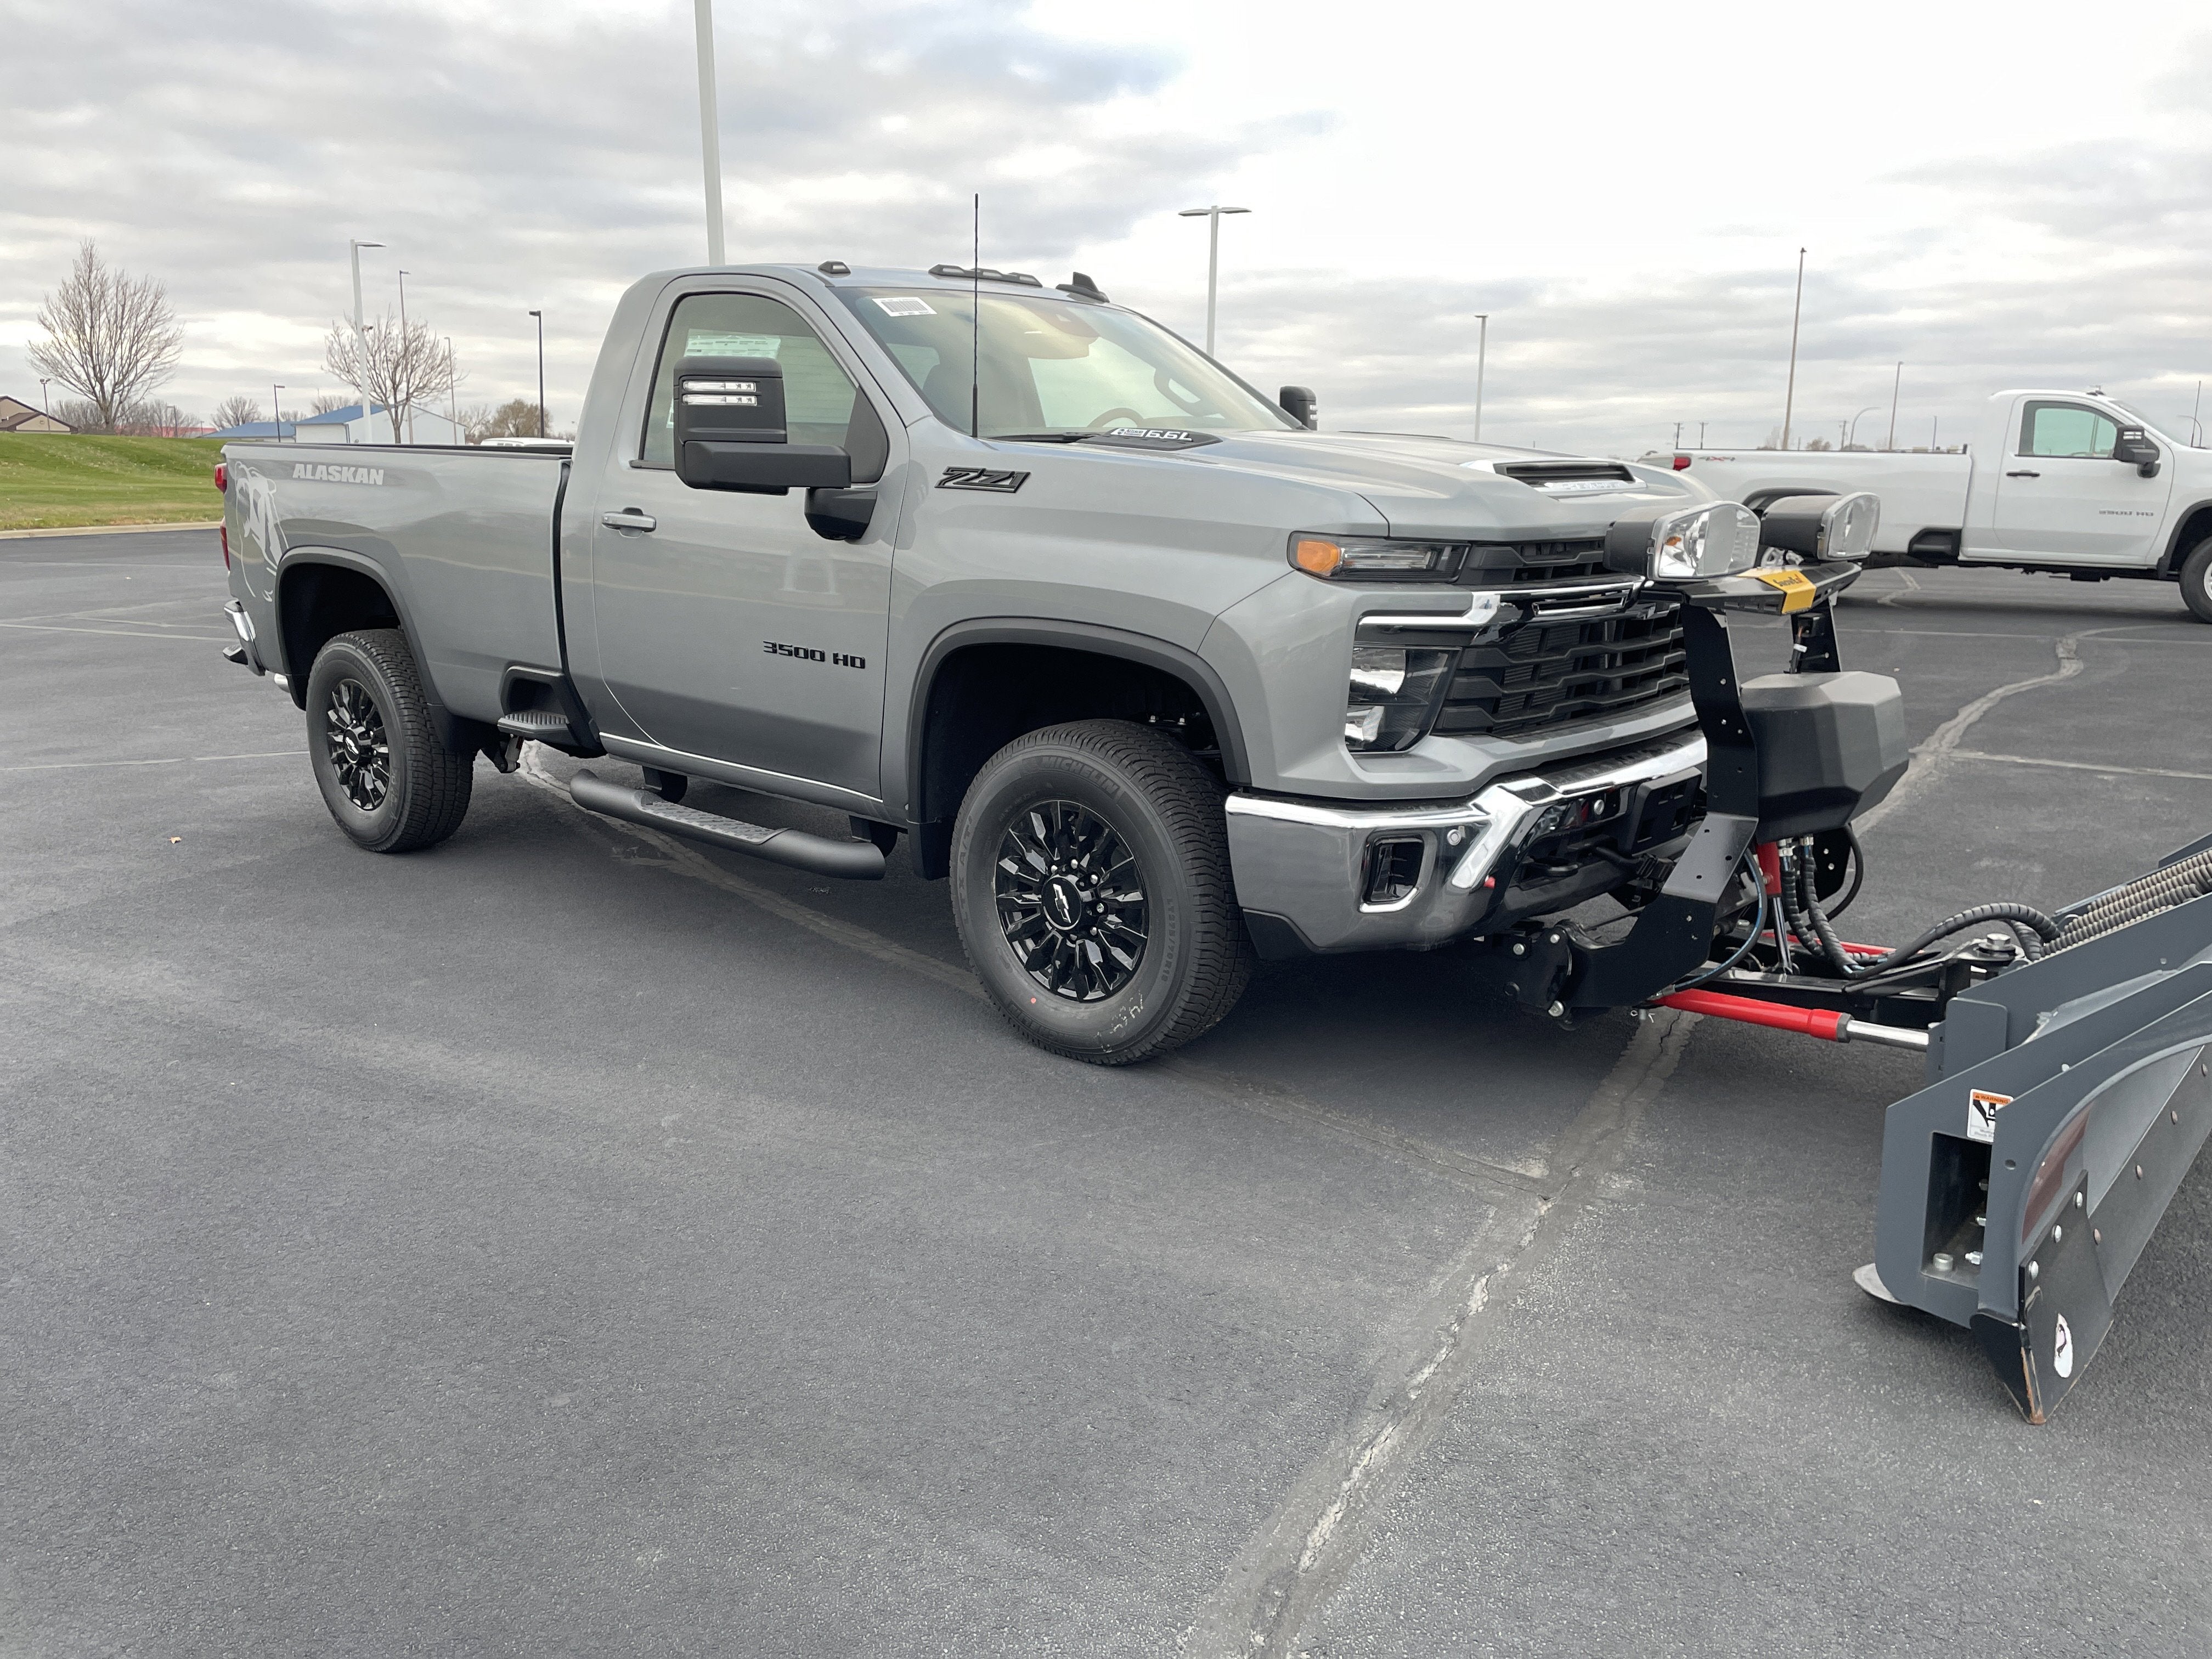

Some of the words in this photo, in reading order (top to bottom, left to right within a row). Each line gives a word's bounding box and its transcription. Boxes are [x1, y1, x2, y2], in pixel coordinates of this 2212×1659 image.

[292, 464, 384, 485] ALASKAN
[934, 466, 1030, 493] Z71
[763, 641, 825, 662] 3500
[833, 652, 865, 669] HD
[1042, 756, 1120, 795] MICHELIN
